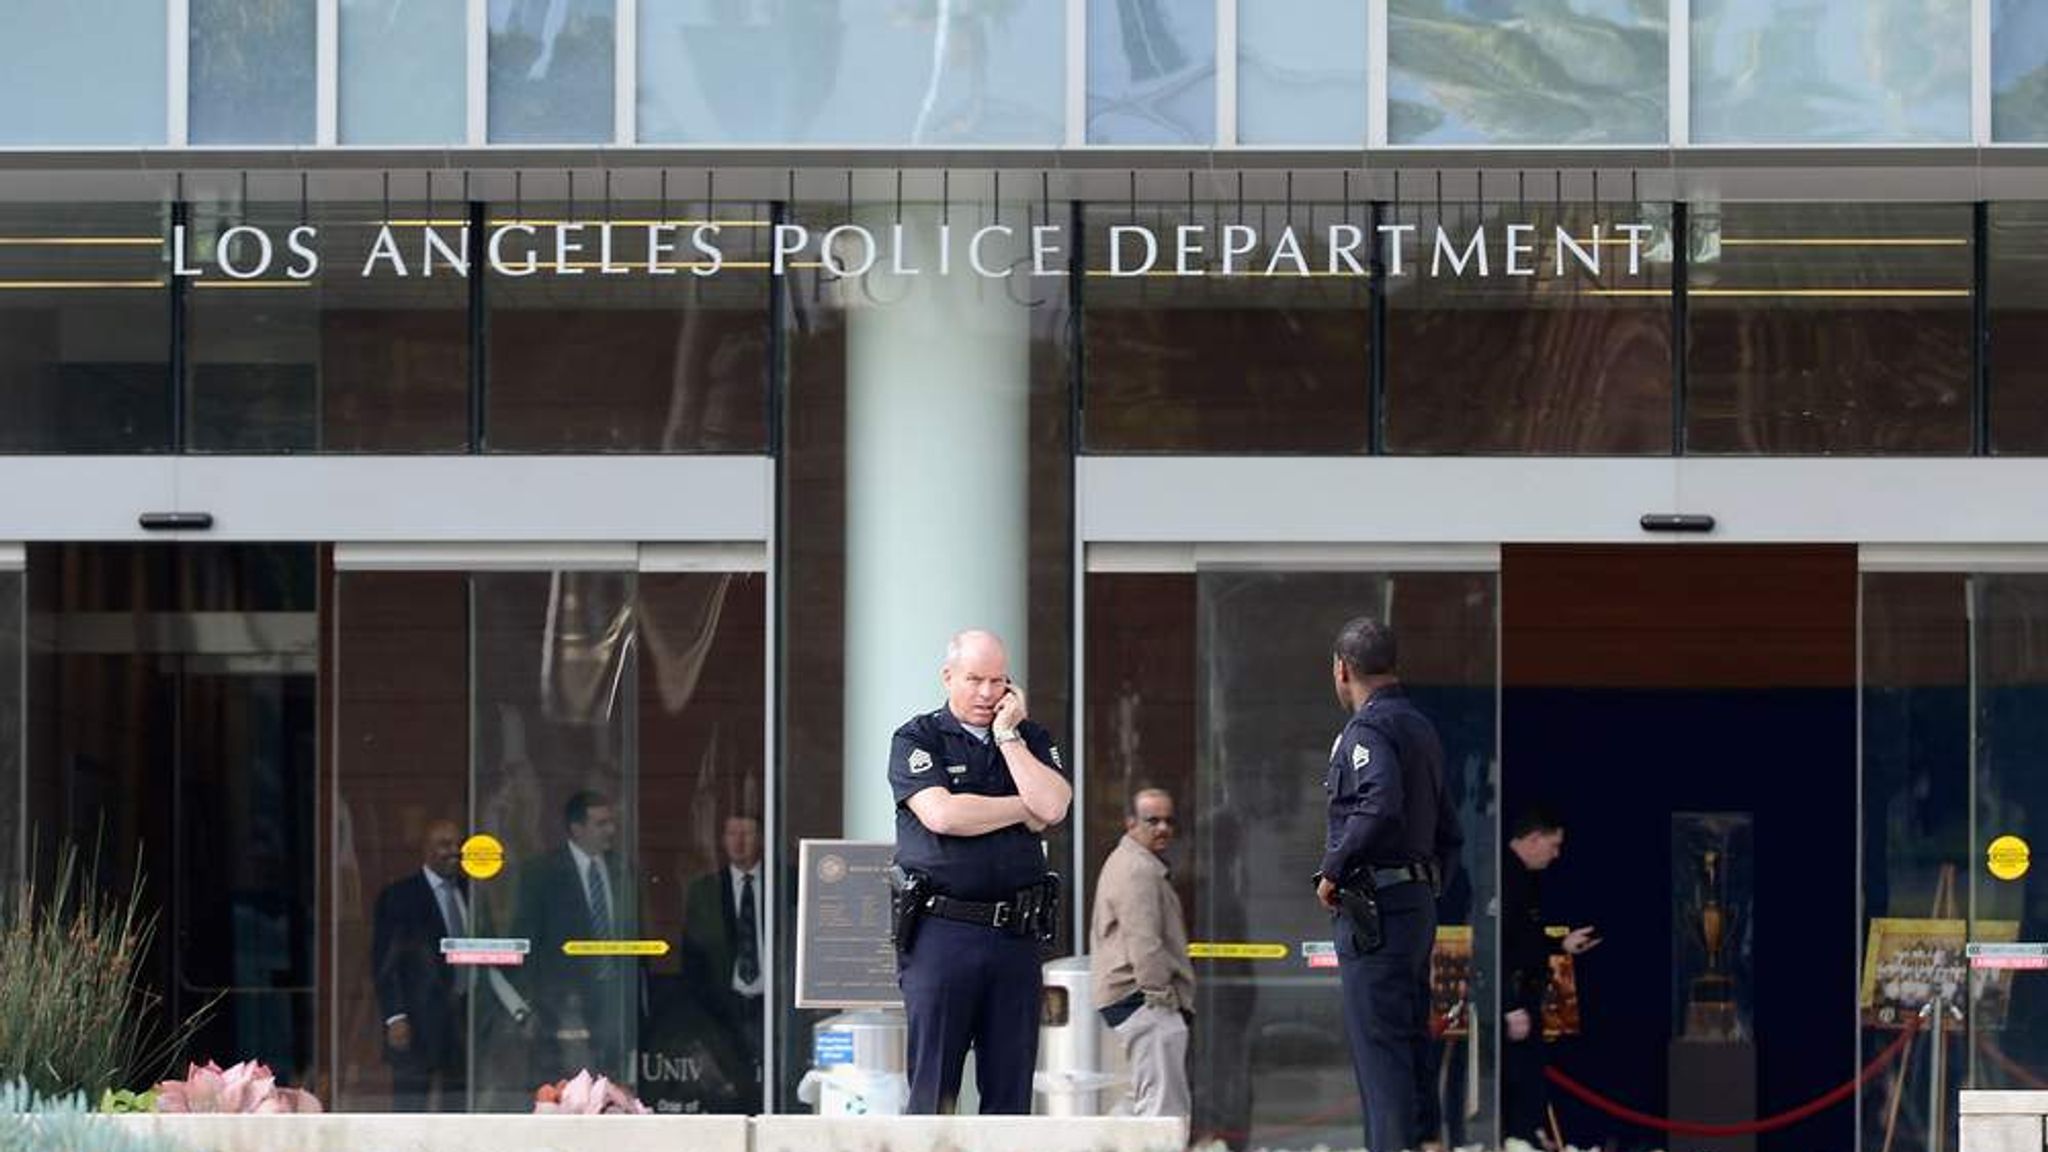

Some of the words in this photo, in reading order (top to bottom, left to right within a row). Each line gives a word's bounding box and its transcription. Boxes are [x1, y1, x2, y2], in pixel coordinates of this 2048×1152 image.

[174, 224, 317, 277] LOS
[362, 222, 723, 277] ANGELES
[773, 224, 1062, 277] POLICE
[1107, 224, 1651, 275] DEPARTMENT
